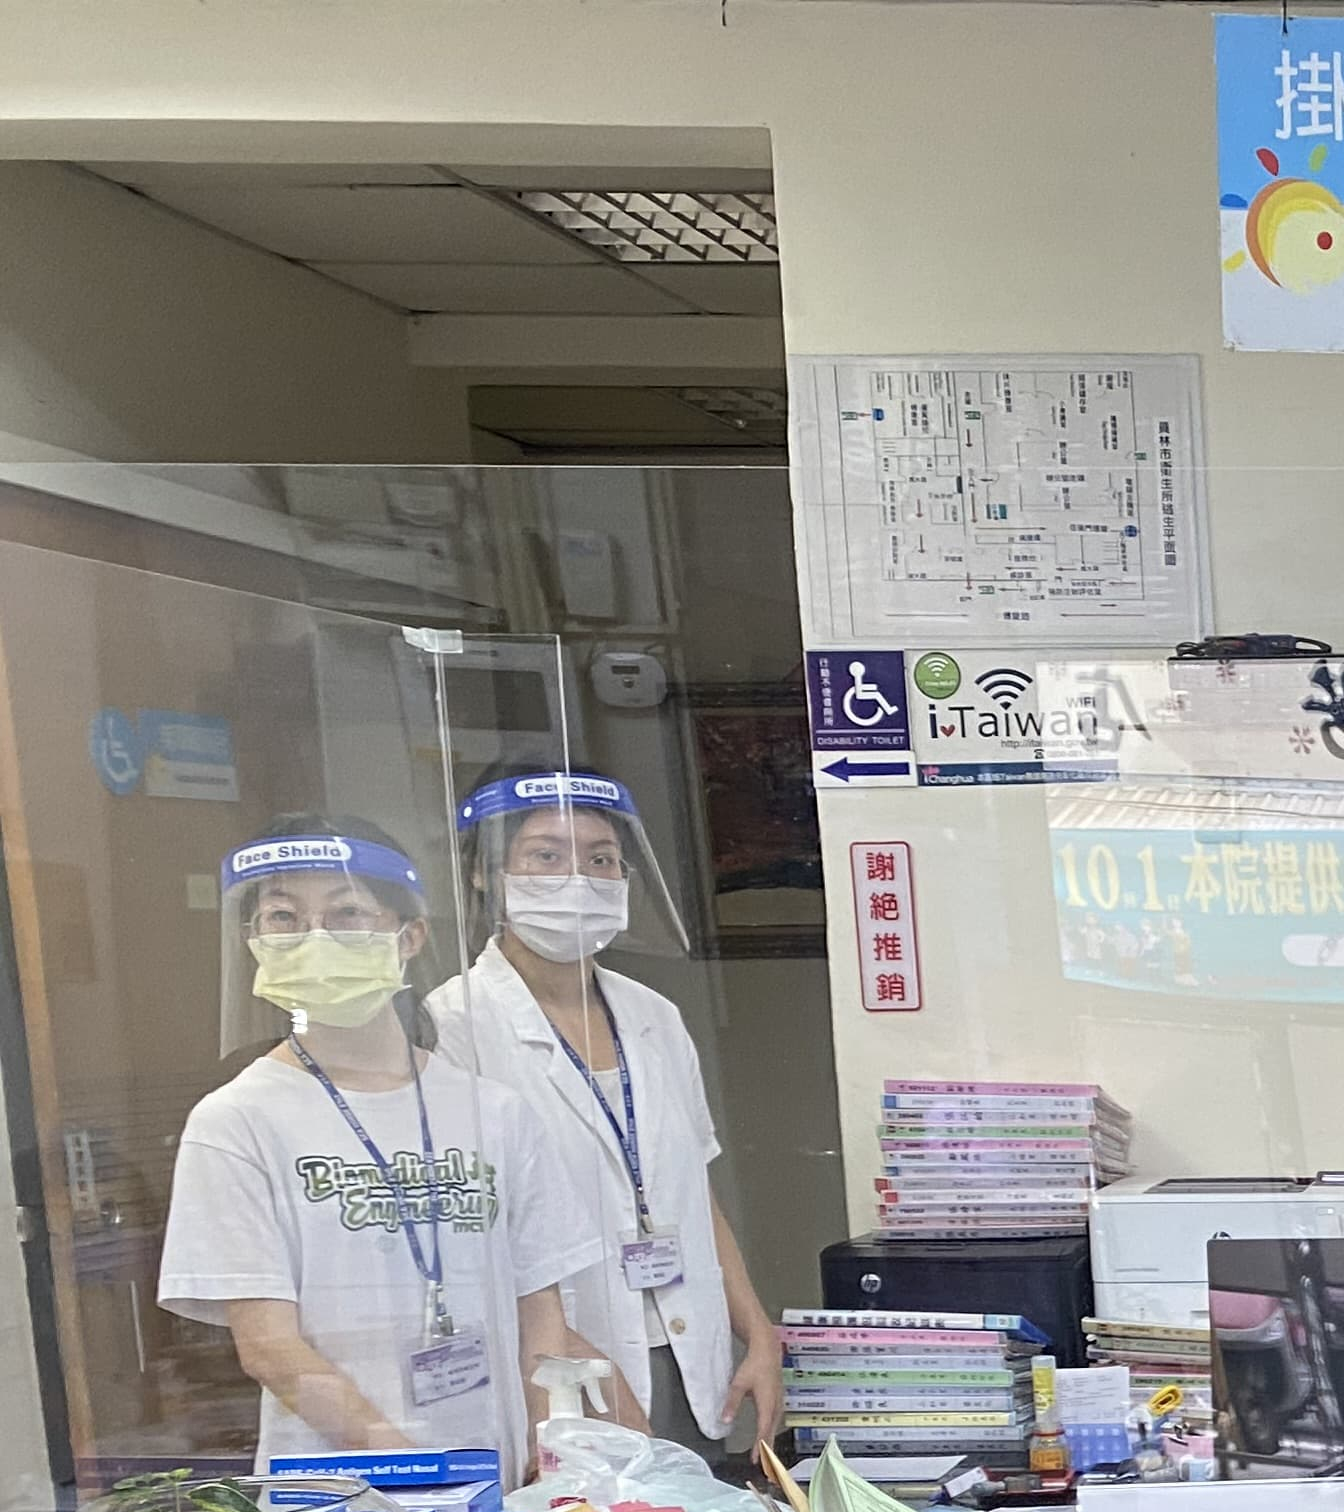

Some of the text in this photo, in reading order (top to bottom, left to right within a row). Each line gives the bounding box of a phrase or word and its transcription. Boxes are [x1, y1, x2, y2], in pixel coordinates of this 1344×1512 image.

[816, 735, 905, 746] DISABILITY TOILET
[570, 781, 615, 797] Shield
[237, 844, 342, 868] Face Shield
[372, 1464, 392, 1476] Self
[393, 1464, 411, 1474] Test
